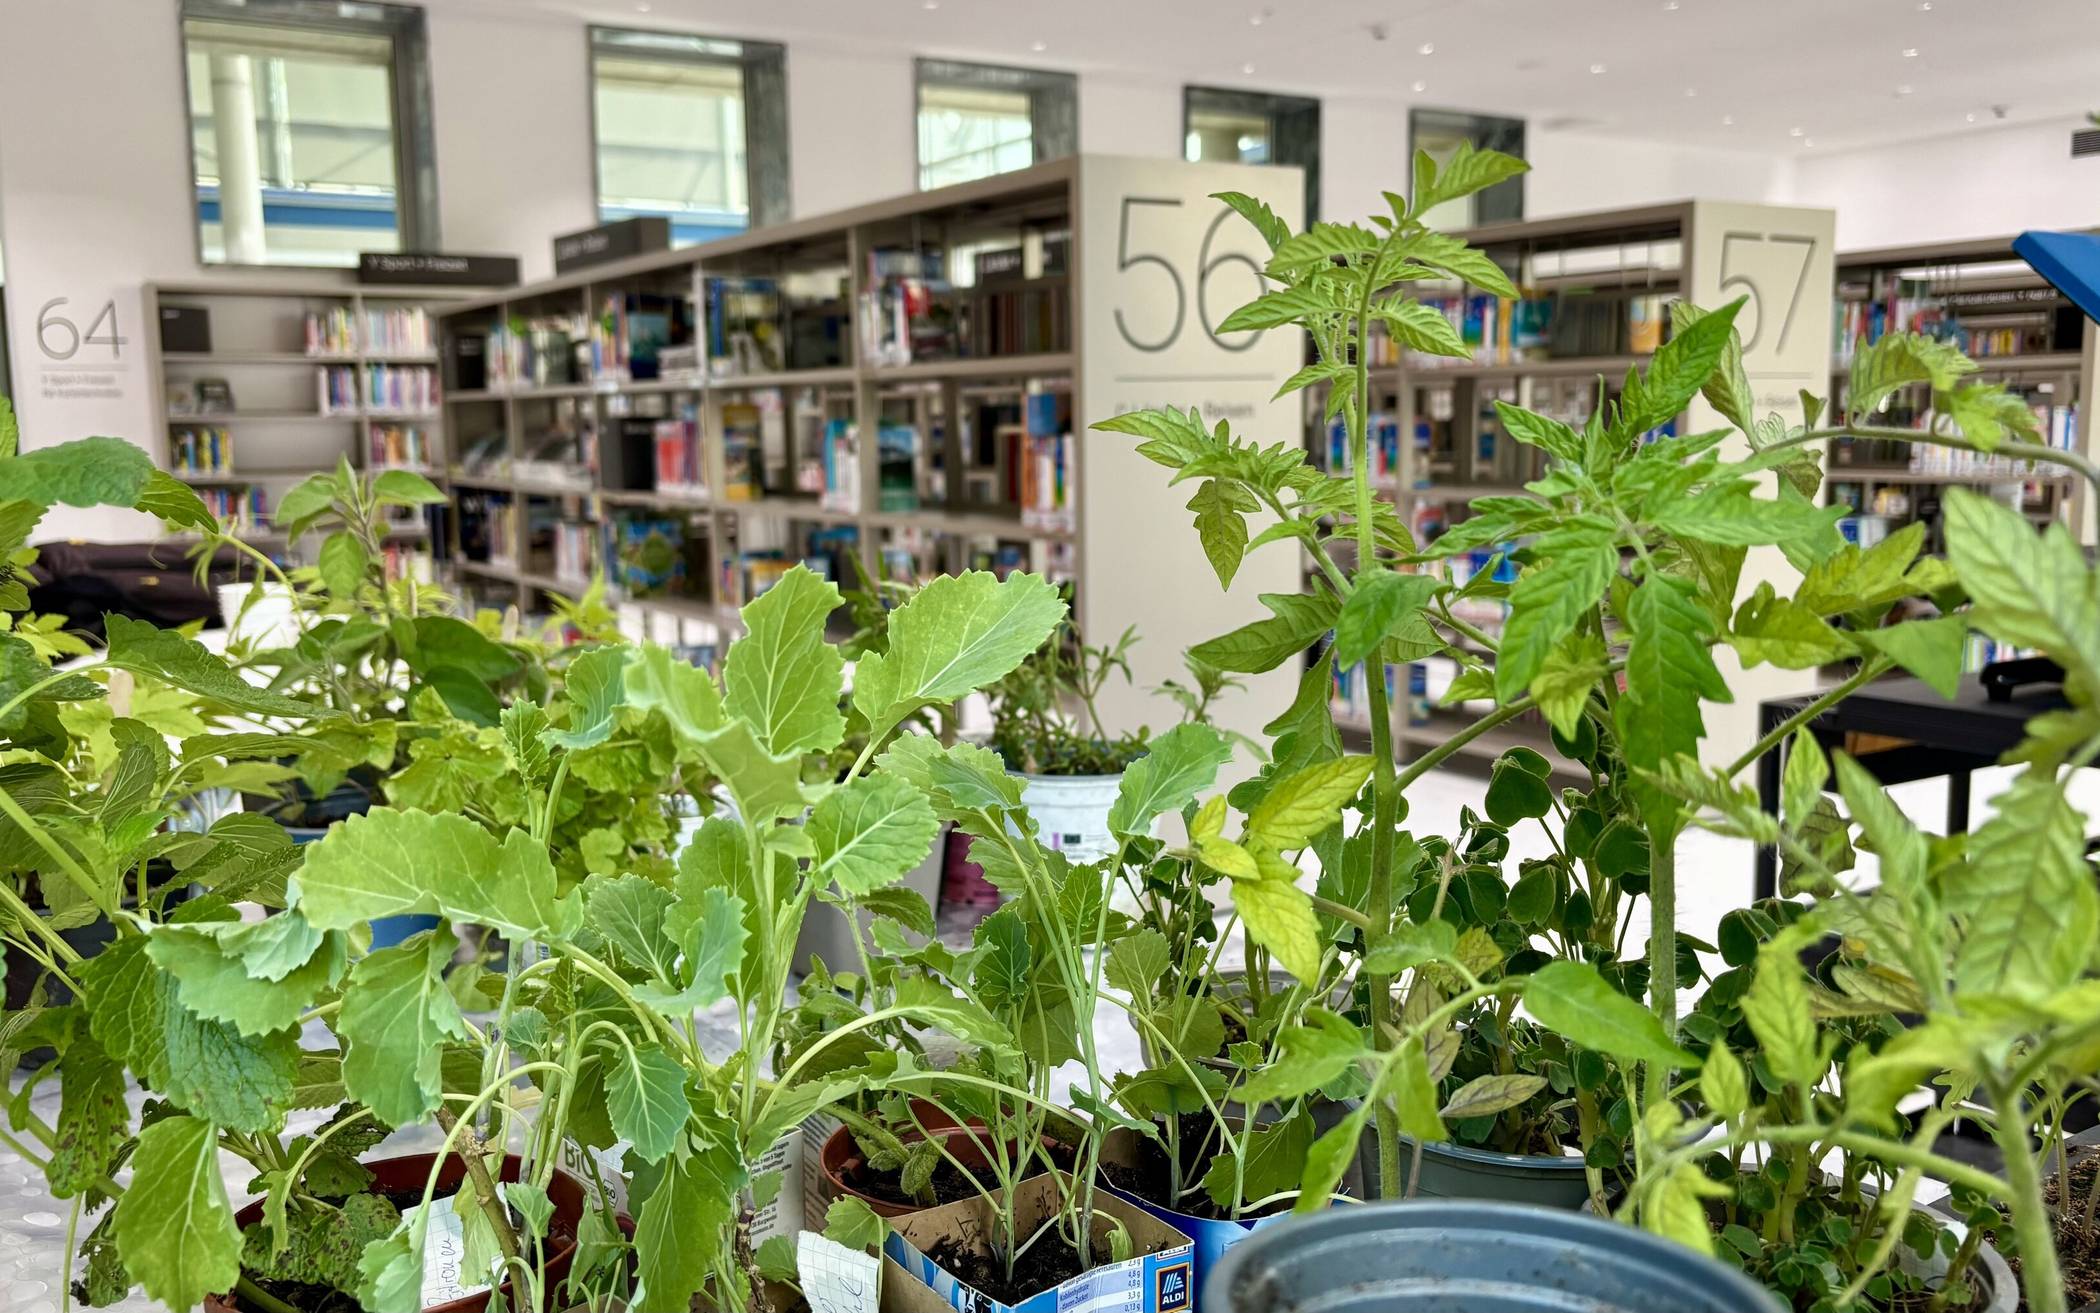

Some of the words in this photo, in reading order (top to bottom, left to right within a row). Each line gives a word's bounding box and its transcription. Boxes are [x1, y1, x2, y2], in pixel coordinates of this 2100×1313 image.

[1113, 193, 1268, 354] 56
[1719, 231, 1817, 356] 57
[37, 296, 128, 361] 64
[1162, 1291, 1185, 1305] ALDI
